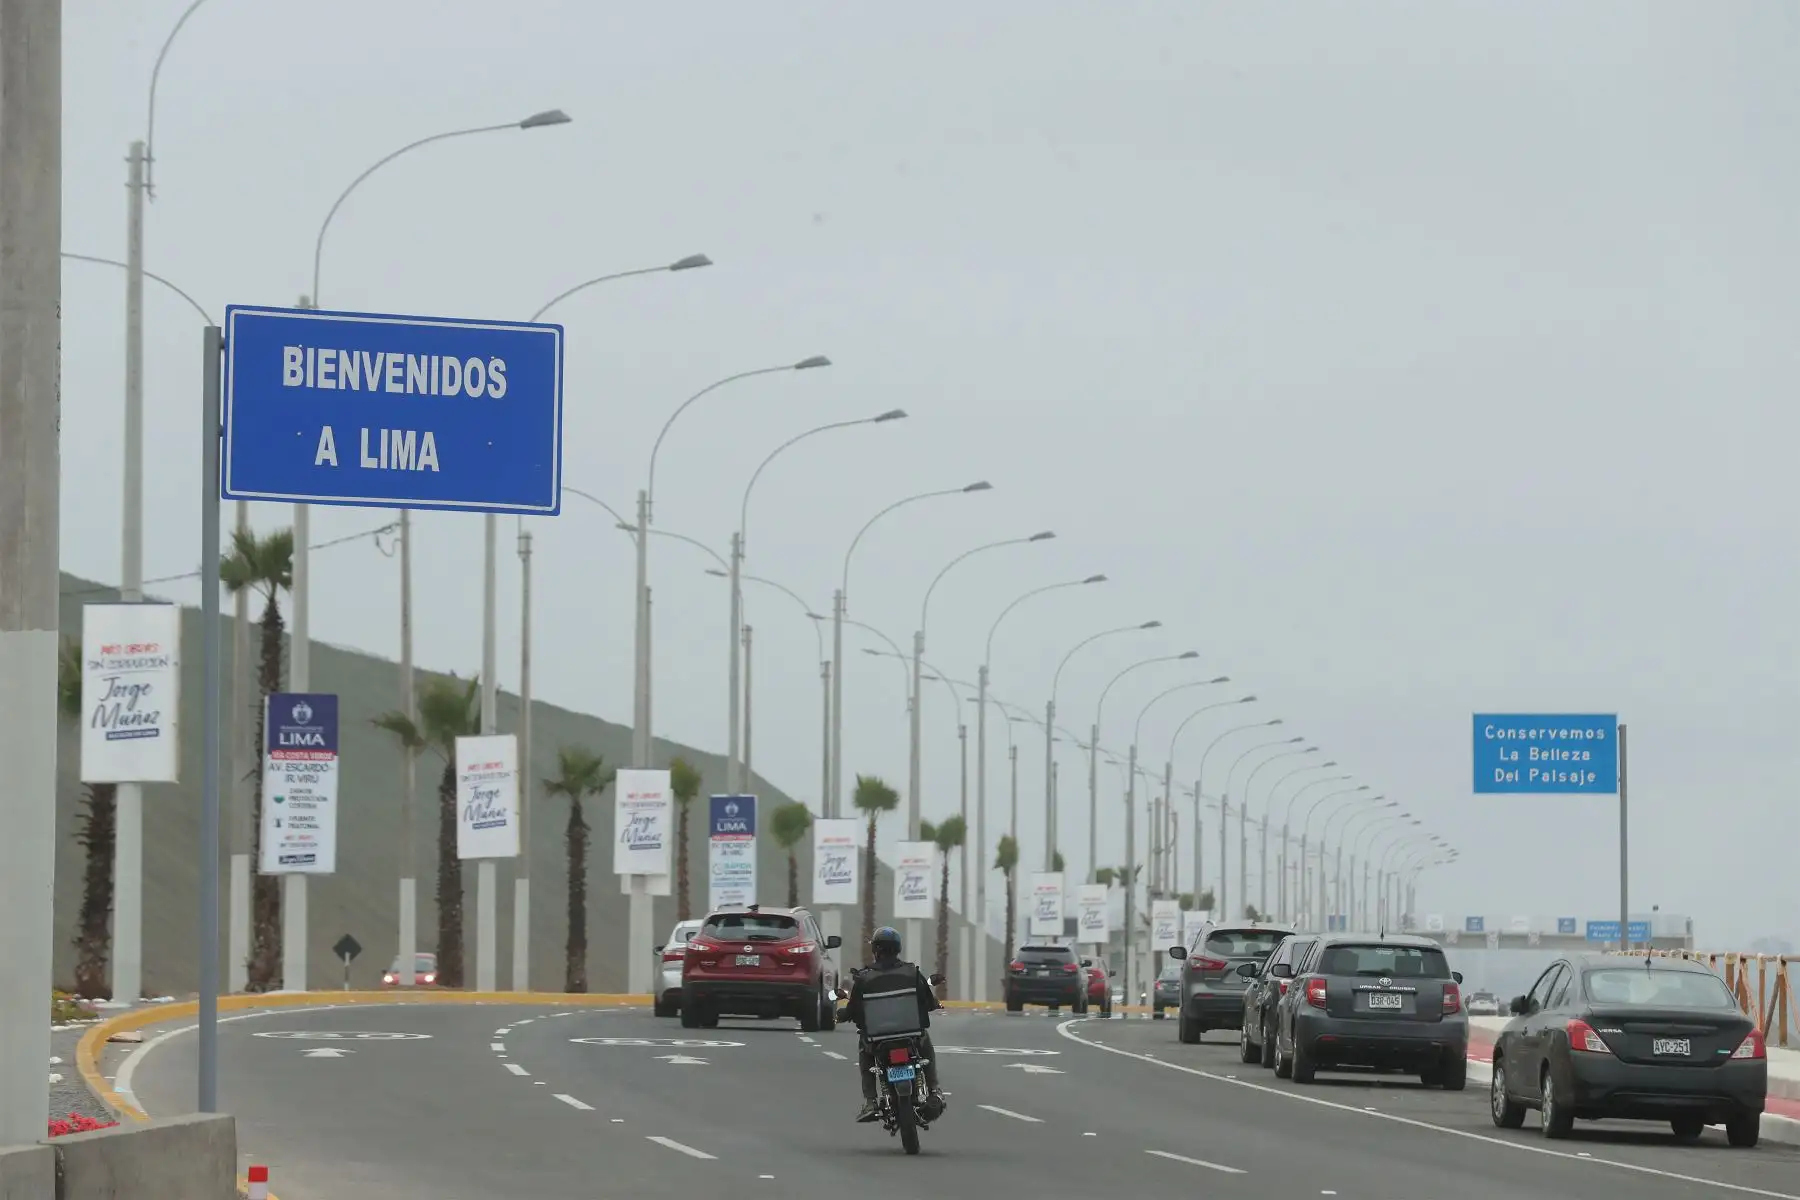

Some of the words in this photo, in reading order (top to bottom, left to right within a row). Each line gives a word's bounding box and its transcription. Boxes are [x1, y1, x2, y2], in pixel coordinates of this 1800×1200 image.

[282, 345, 508, 399] BIENVENIDOS
[314, 425, 338, 467] A
[360, 427, 440, 472] LIMA
[98, 676, 152, 712] Jorge
[279, 732, 326, 746] LIMA
[1485, 725, 1605, 740] Conservemos
[1500, 746, 1519, 761] La
[1529, 747, 1591, 761] Belleza
[1495, 768, 1519, 782] Del
[467, 786, 500, 809] Jorge
[717, 822, 747, 831] LIMA
[1655, 1041, 1690, 1054] AYC-251
